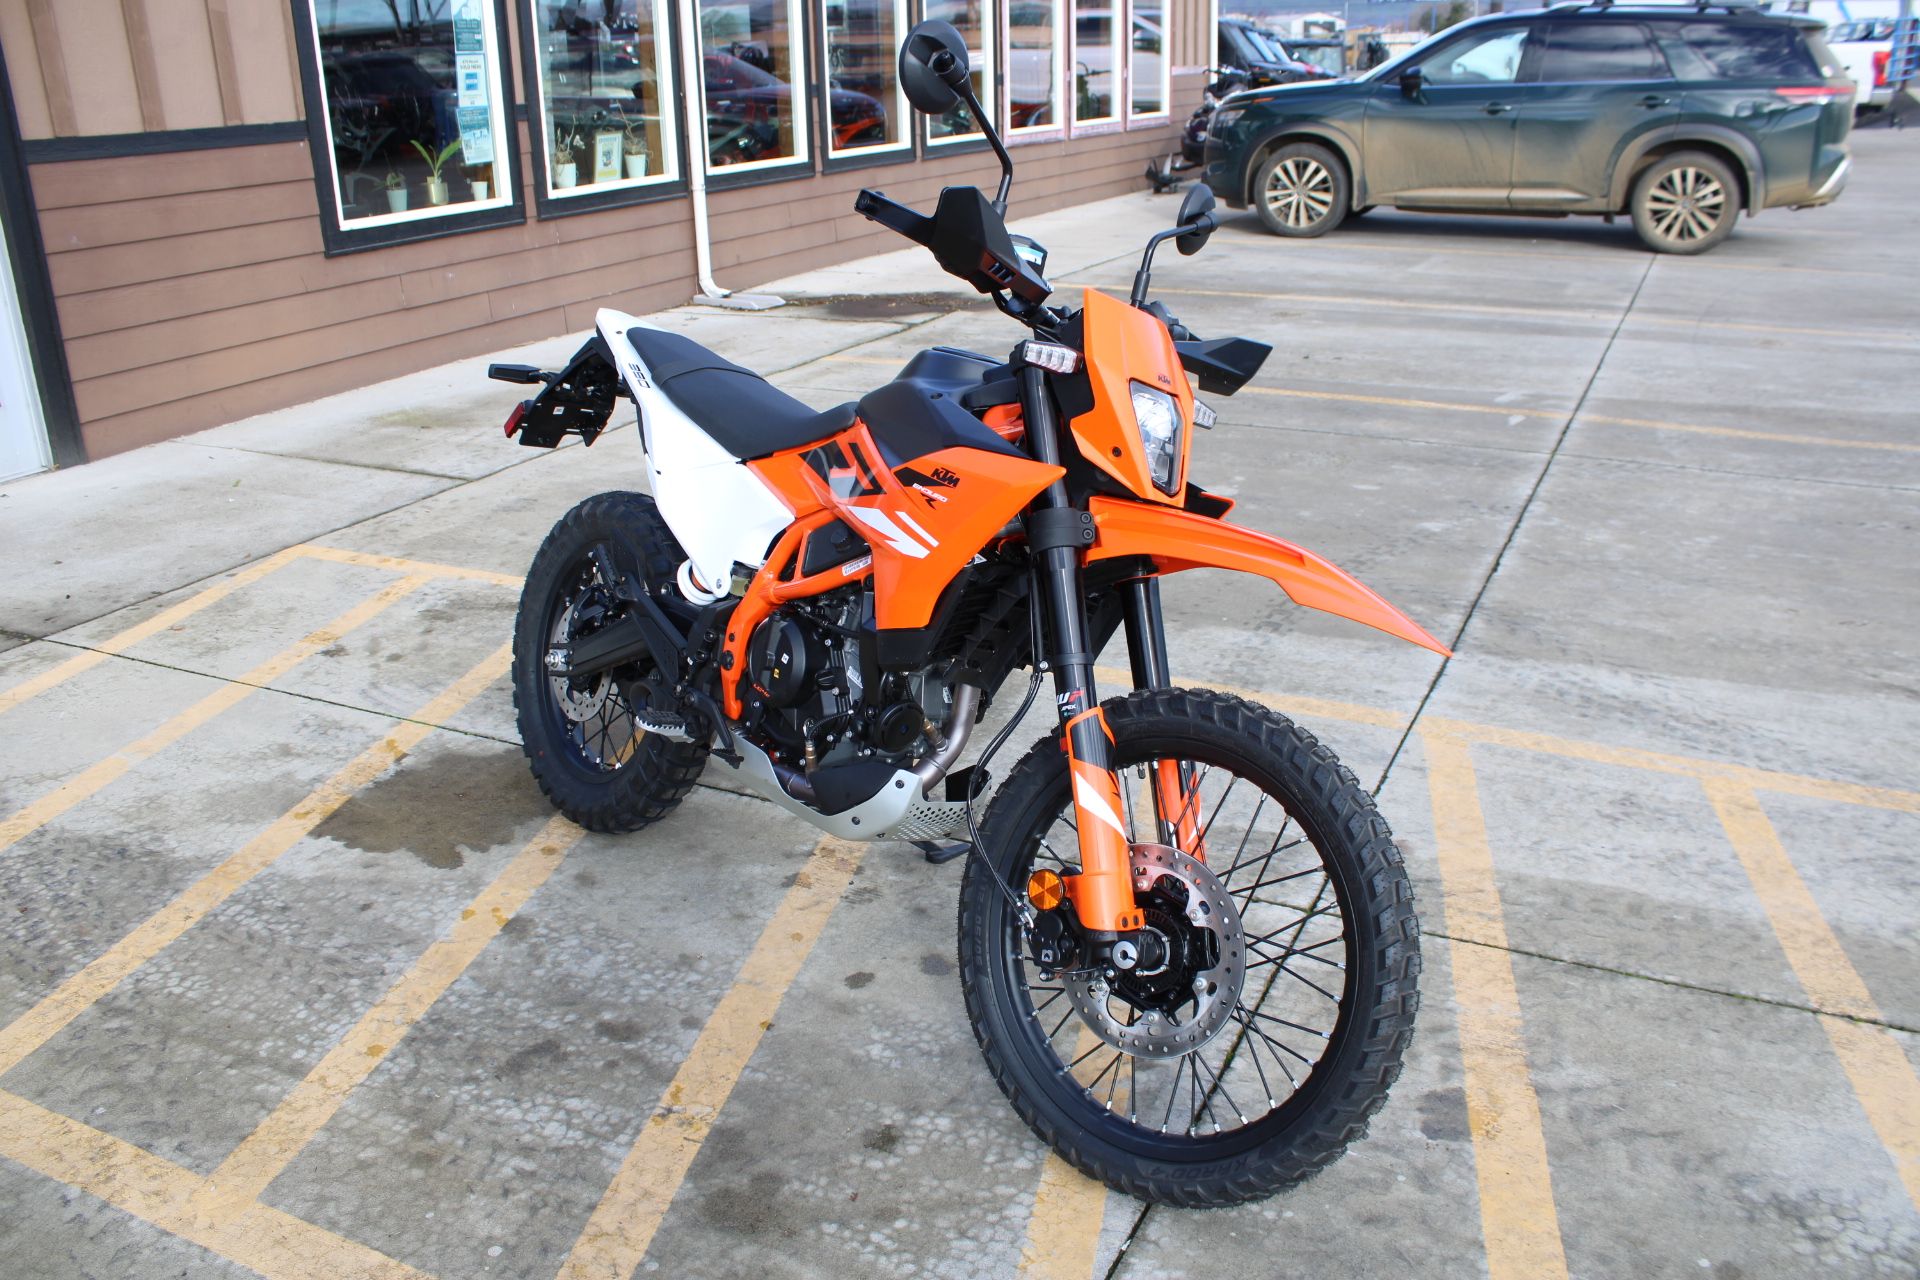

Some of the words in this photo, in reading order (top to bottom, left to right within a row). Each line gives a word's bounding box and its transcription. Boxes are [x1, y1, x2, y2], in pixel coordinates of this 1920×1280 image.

[1157, 373, 1171, 384] KTM
[930, 467, 960, 488] KTM
[912, 483, 947, 502] ENDURO
